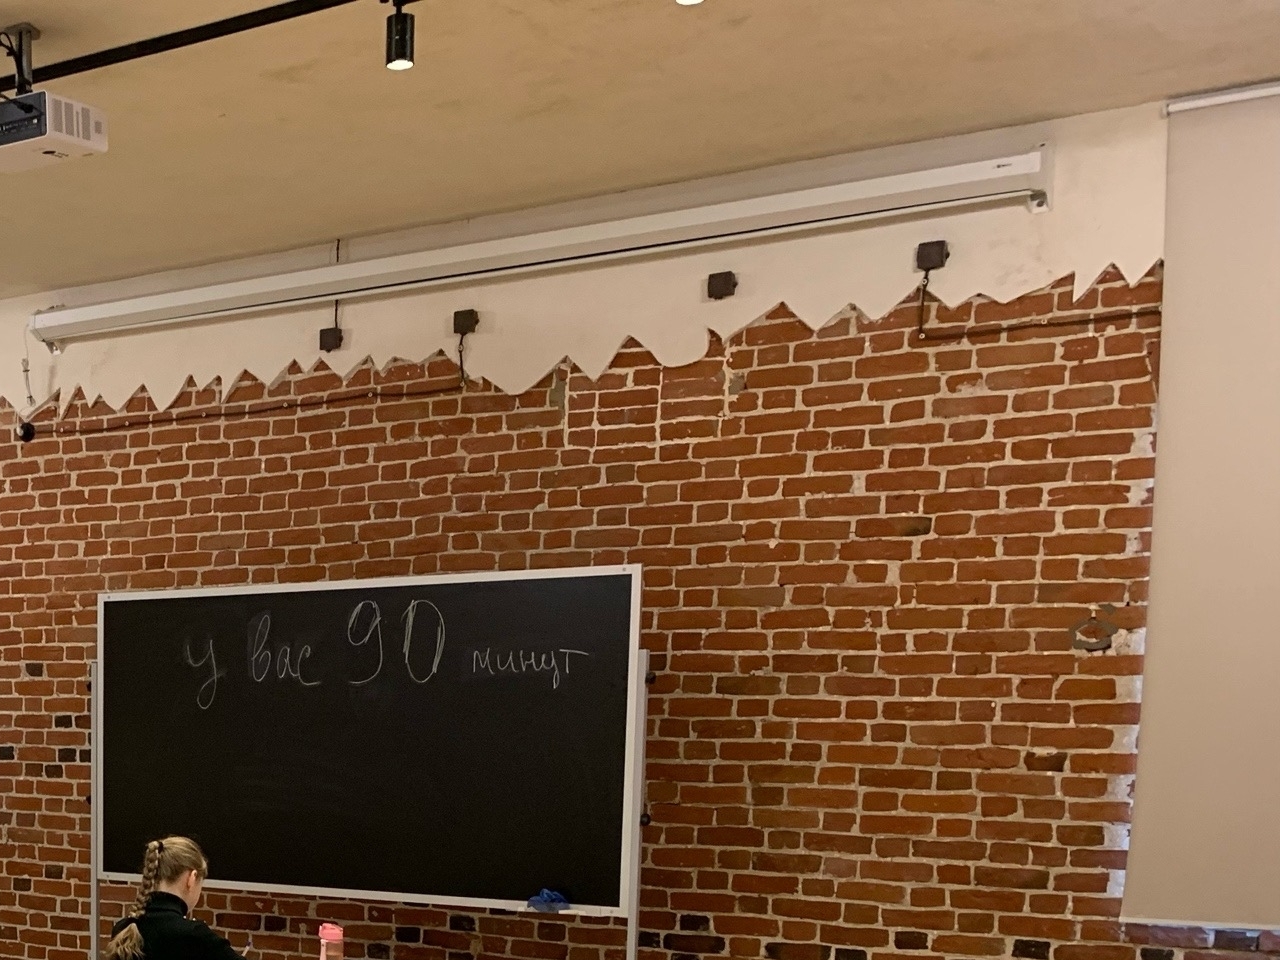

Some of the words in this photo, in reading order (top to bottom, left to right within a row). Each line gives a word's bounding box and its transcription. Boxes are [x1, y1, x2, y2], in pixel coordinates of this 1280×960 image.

[250, 614, 321, 686] вас
[346, 600, 446, 684] 90
[472, 646, 590, 690] минут
